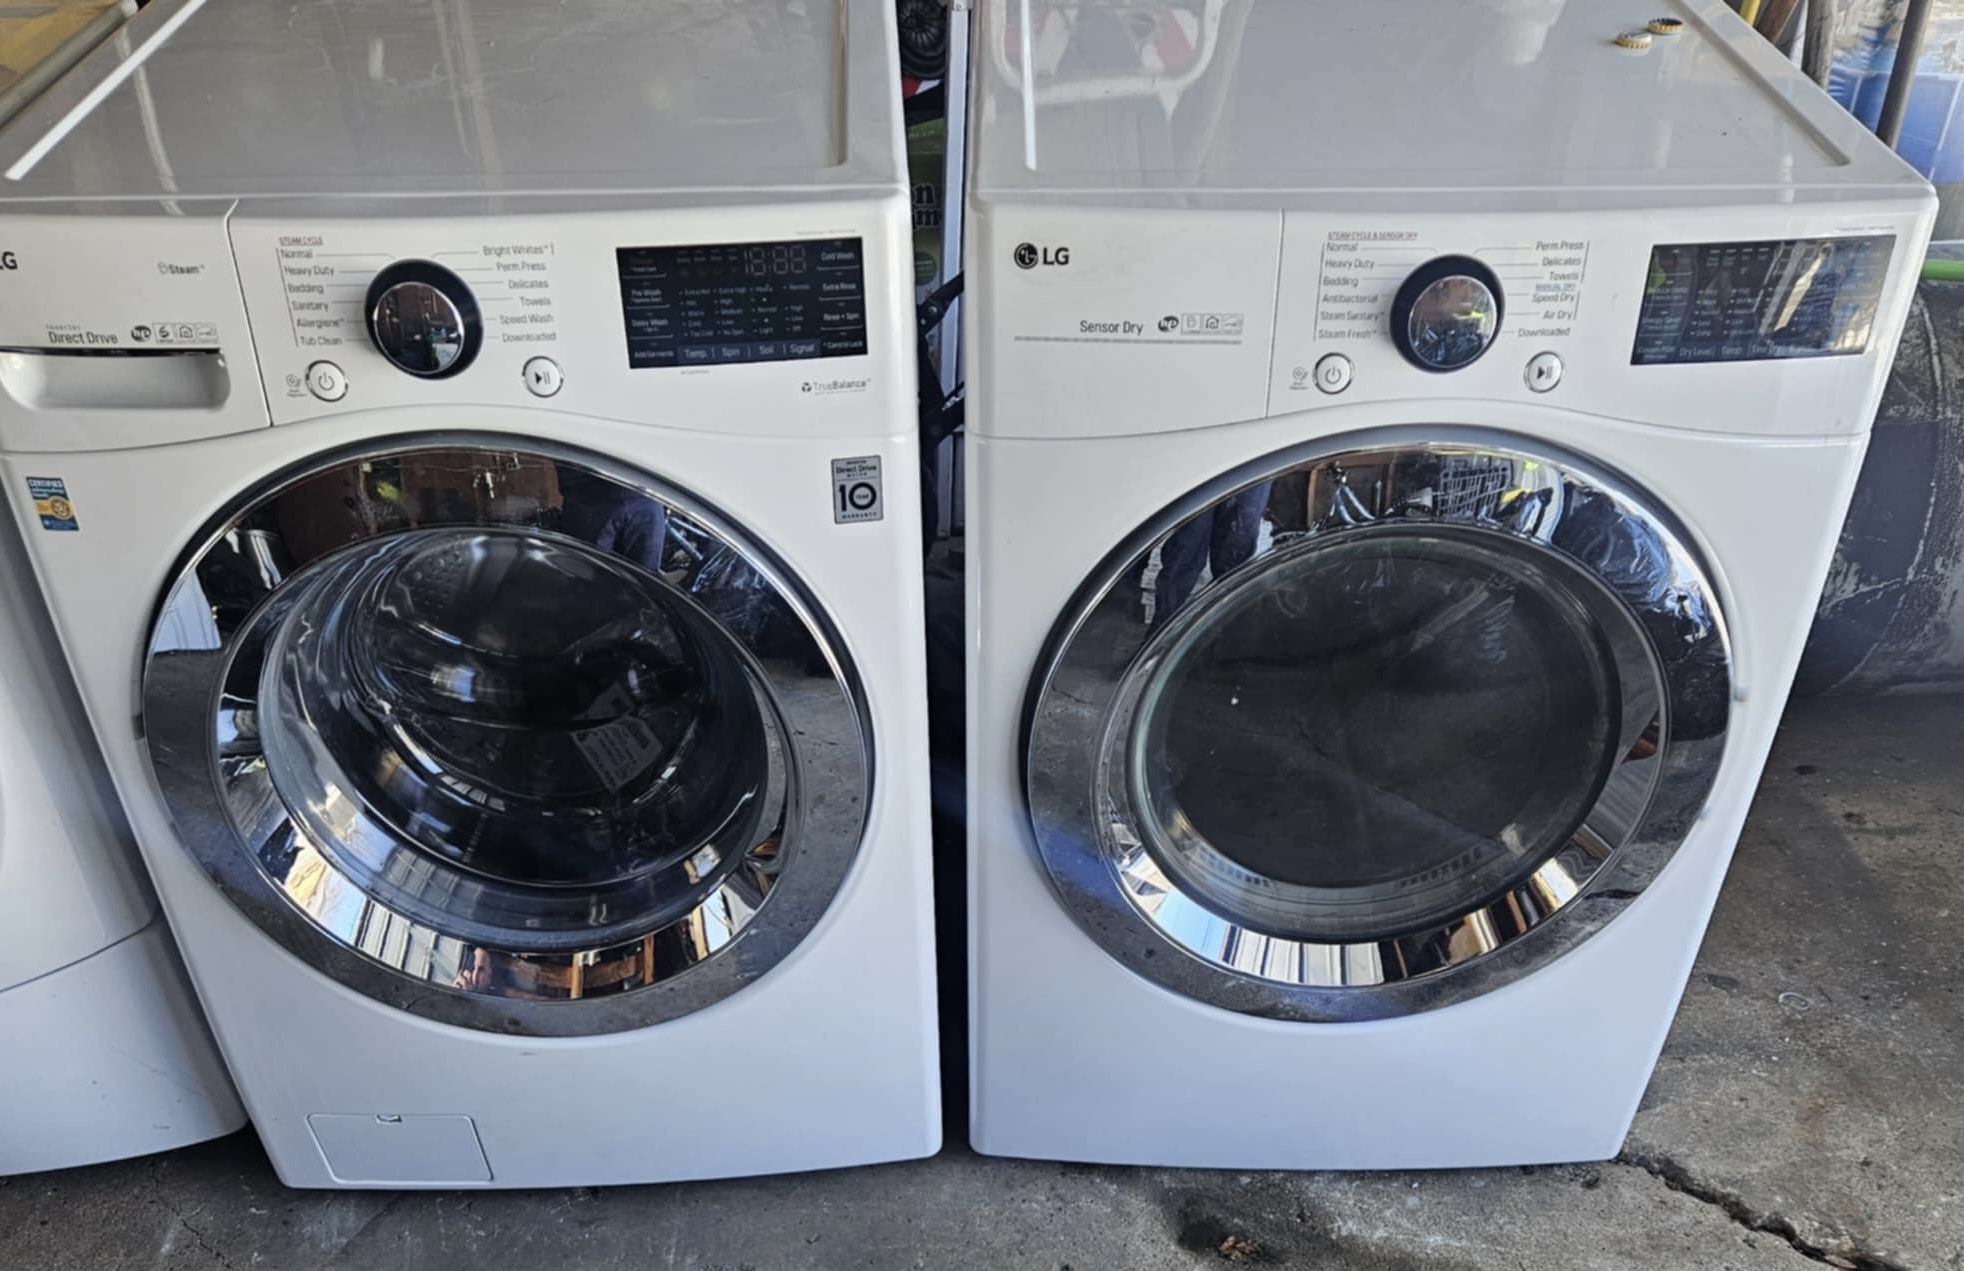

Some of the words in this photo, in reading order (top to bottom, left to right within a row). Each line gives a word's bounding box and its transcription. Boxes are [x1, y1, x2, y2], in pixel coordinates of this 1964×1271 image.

[1327, 242, 1359, 251] Normal
[1560, 241, 1584, 250] Press
[280, 248, 313, 258] Normal
[483, 245, 511, 257] Bright
[0, 251, 18, 270] G
[1042, 247, 1070, 266] LG
[1542, 257, 1581, 266] Delicates
[168, 263, 200, 274] Steam
[521, 262, 547, 271] Press
[1325, 259, 1353, 269] Heavy
[1354, 260, 1375, 269] Duty
[284, 266, 312, 276] Heavy
[314, 265, 335, 275] Duty
[1549, 271, 1580, 280] Towels
[508, 279, 550, 288] Delicates
[1323, 277, 1359, 287] Bedding
[288, 284, 324, 294] Bedding
[519, 296, 551, 306] Towels
[1322, 294, 1378, 303] Antibacterial
[1532, 293, 1559, 303] Speed
[1560, 293, 1575, 303] Dry
[291, 300, 329, 311] Sanitary
[499, 314, 527, 325] Speed
[528, 314, 554, 323] Wash
[1320, 311, 1345, 320] Steam
[1347, 311, 1379, 321] Sanitary
[1543, 310, 1556, 319] Air
[1557, 310, 1574, 320] Dry
[1080, 320, 1119, 334] Sensor
[1123, 320, 1143, 335] Dry
[48, 331, 85, 345] Direct
[86, 331, 118, 345] Drive
[502, 332, 558, 342] Downloaded
[1318, 329, 1346, 338] Steam
[1347, 329, 1371, 338] Fresh
[1518, 328, 1571, 338] Downloaded
[300, 336, 316, 345] Tub
[318, 336, 342, 345] Clean
[722, 347, 741, 358] Spin
[759, 344, 775, 356] Soil
[790, 343, 816, 355] Signal
[813, 380, 867, 392] TrueBalance
[836, 465, 857, 474] Direct
[858, 464, 877, 472] Drive
[839, 482, 877, 512] 10
